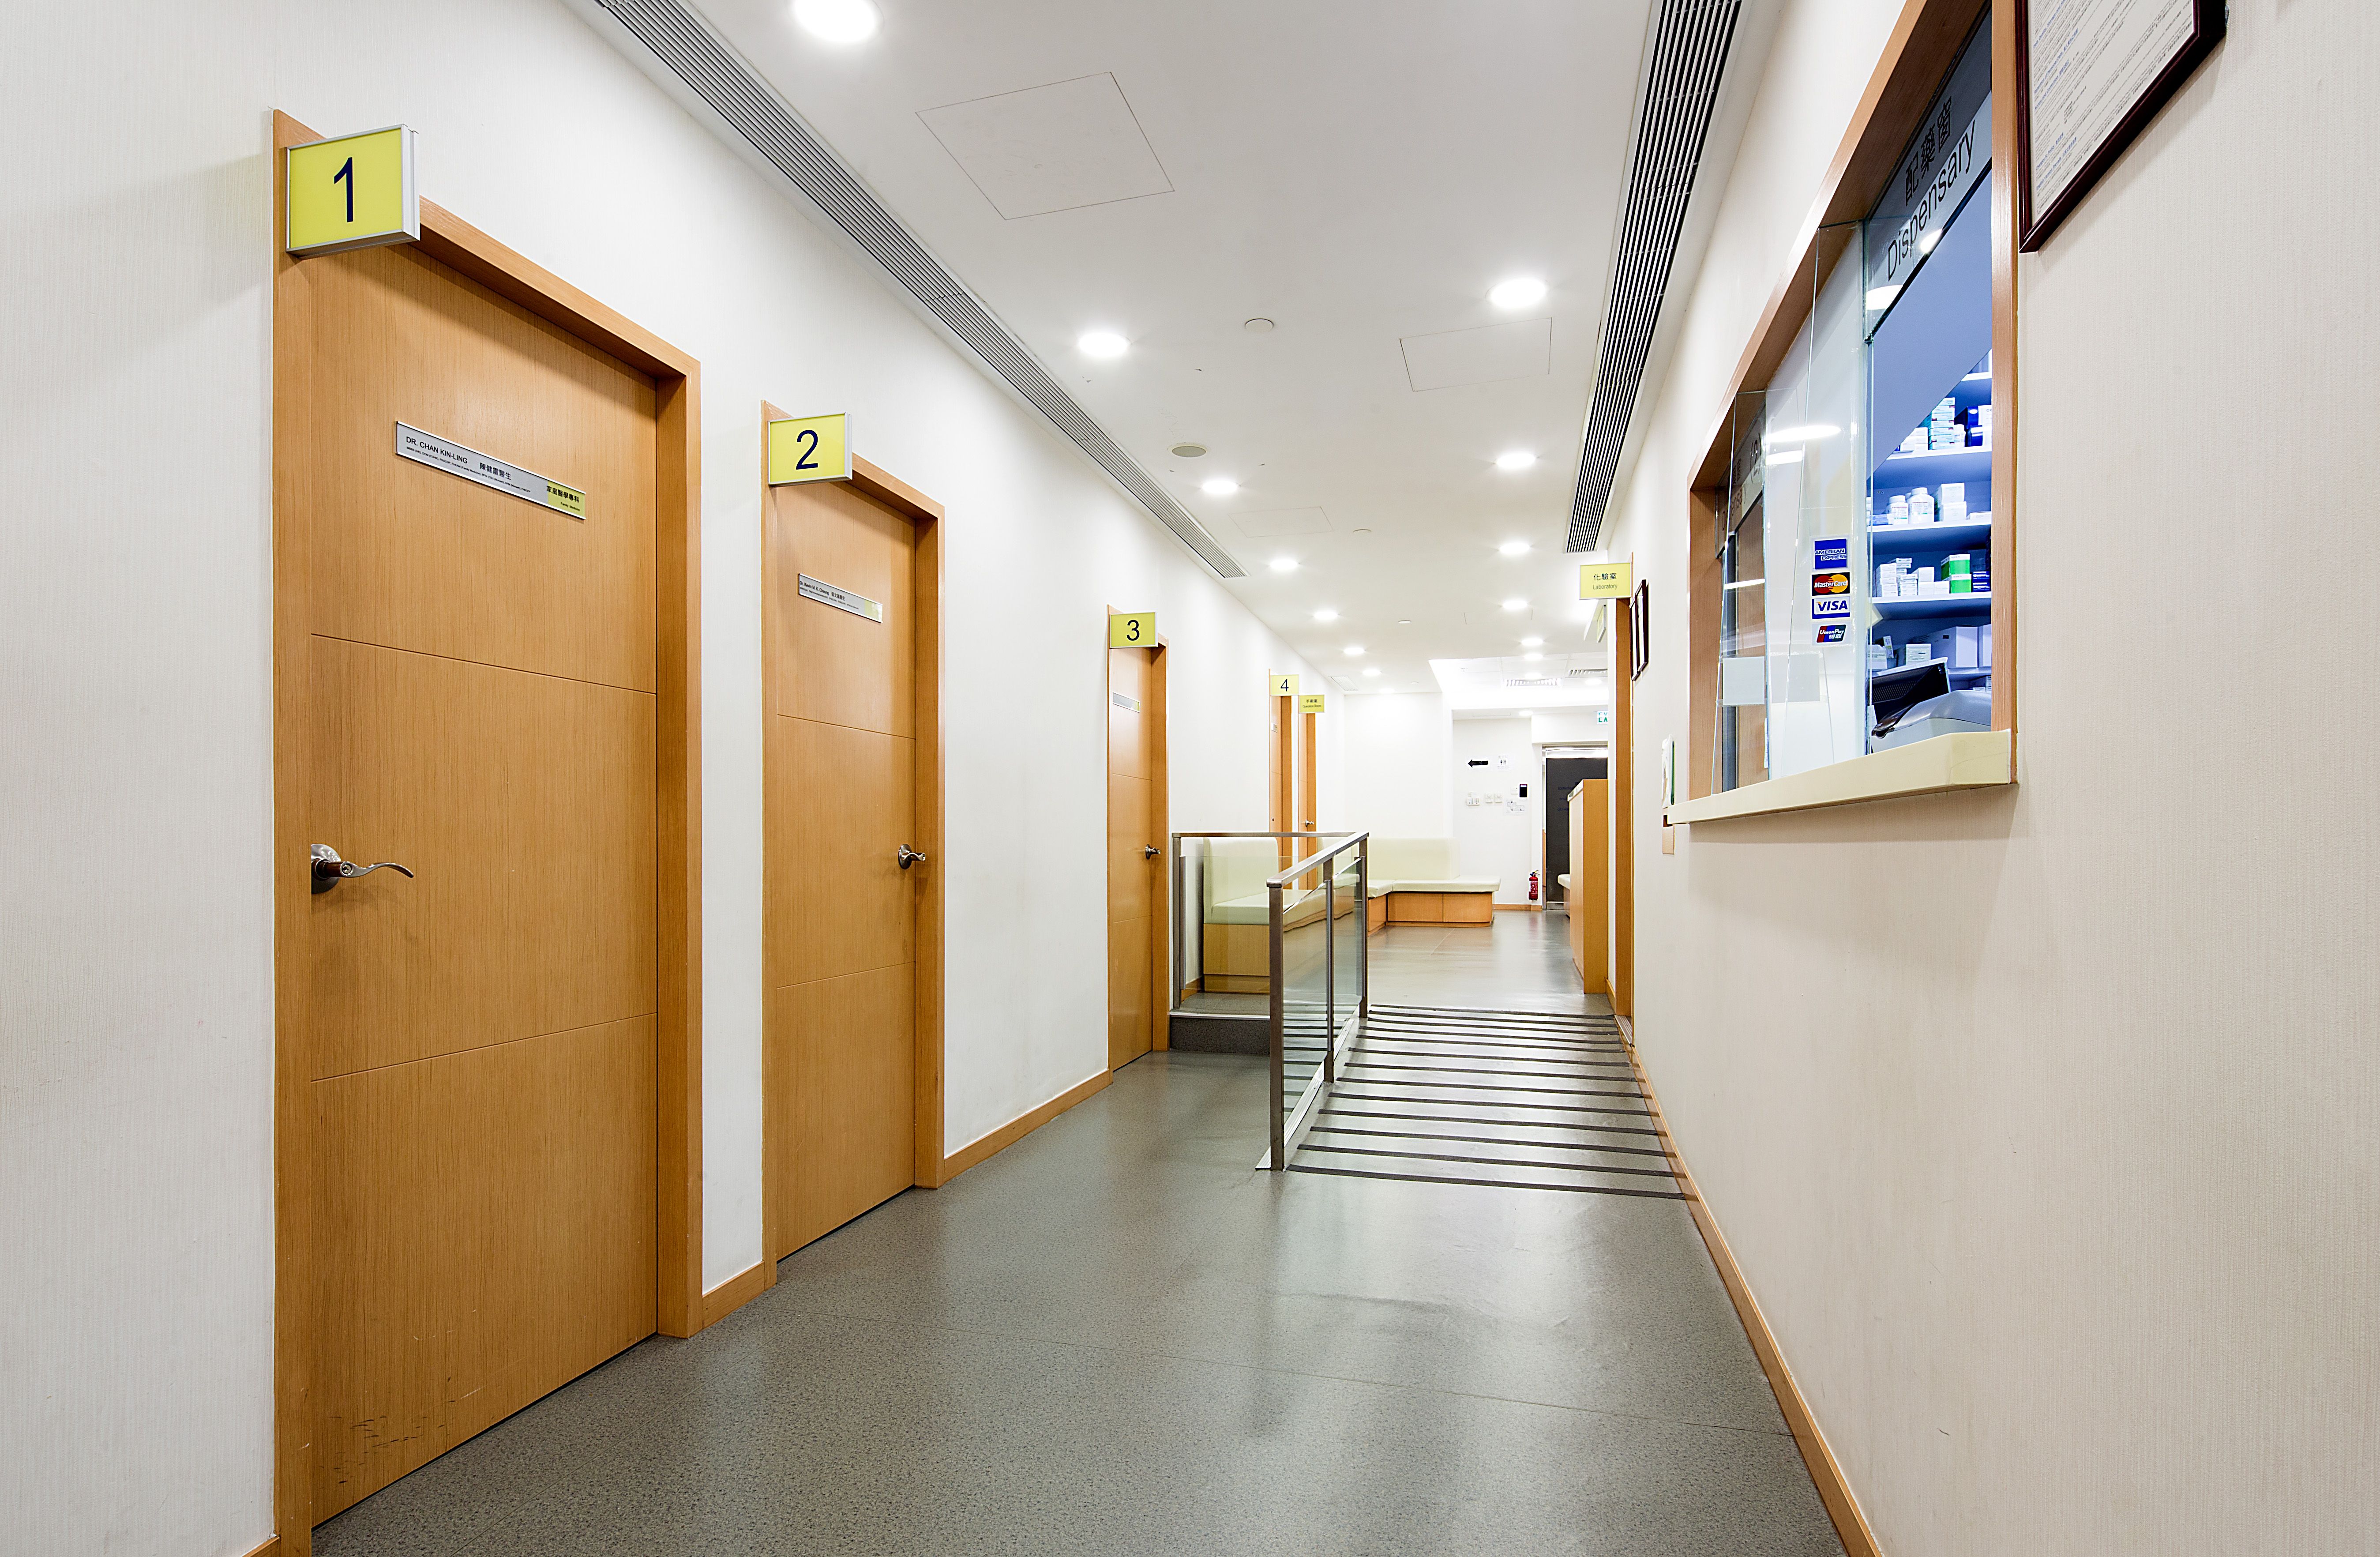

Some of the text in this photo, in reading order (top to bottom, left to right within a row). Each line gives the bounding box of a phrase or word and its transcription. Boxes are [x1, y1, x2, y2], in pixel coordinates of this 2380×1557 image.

[1906, 96, 1952, 206] 配藥窗
[334, 157, 353, 222] 1
[1888, 120, 1975, 282] Dispensary
[406, 436, 468, 464] DR. CHAN KIN-LING
[796, 429, 818, 470] 2
[1750, 431, 1762, 483] (2)
[1594, 572, 1617, 581] 化驗室
[1814, 579, 1848, 592] MasterCard
[1816, 600, 1848, 611] VISA
[1126, 620, 1140, 641] 3
[1280, 679, 1289, 692] 4
